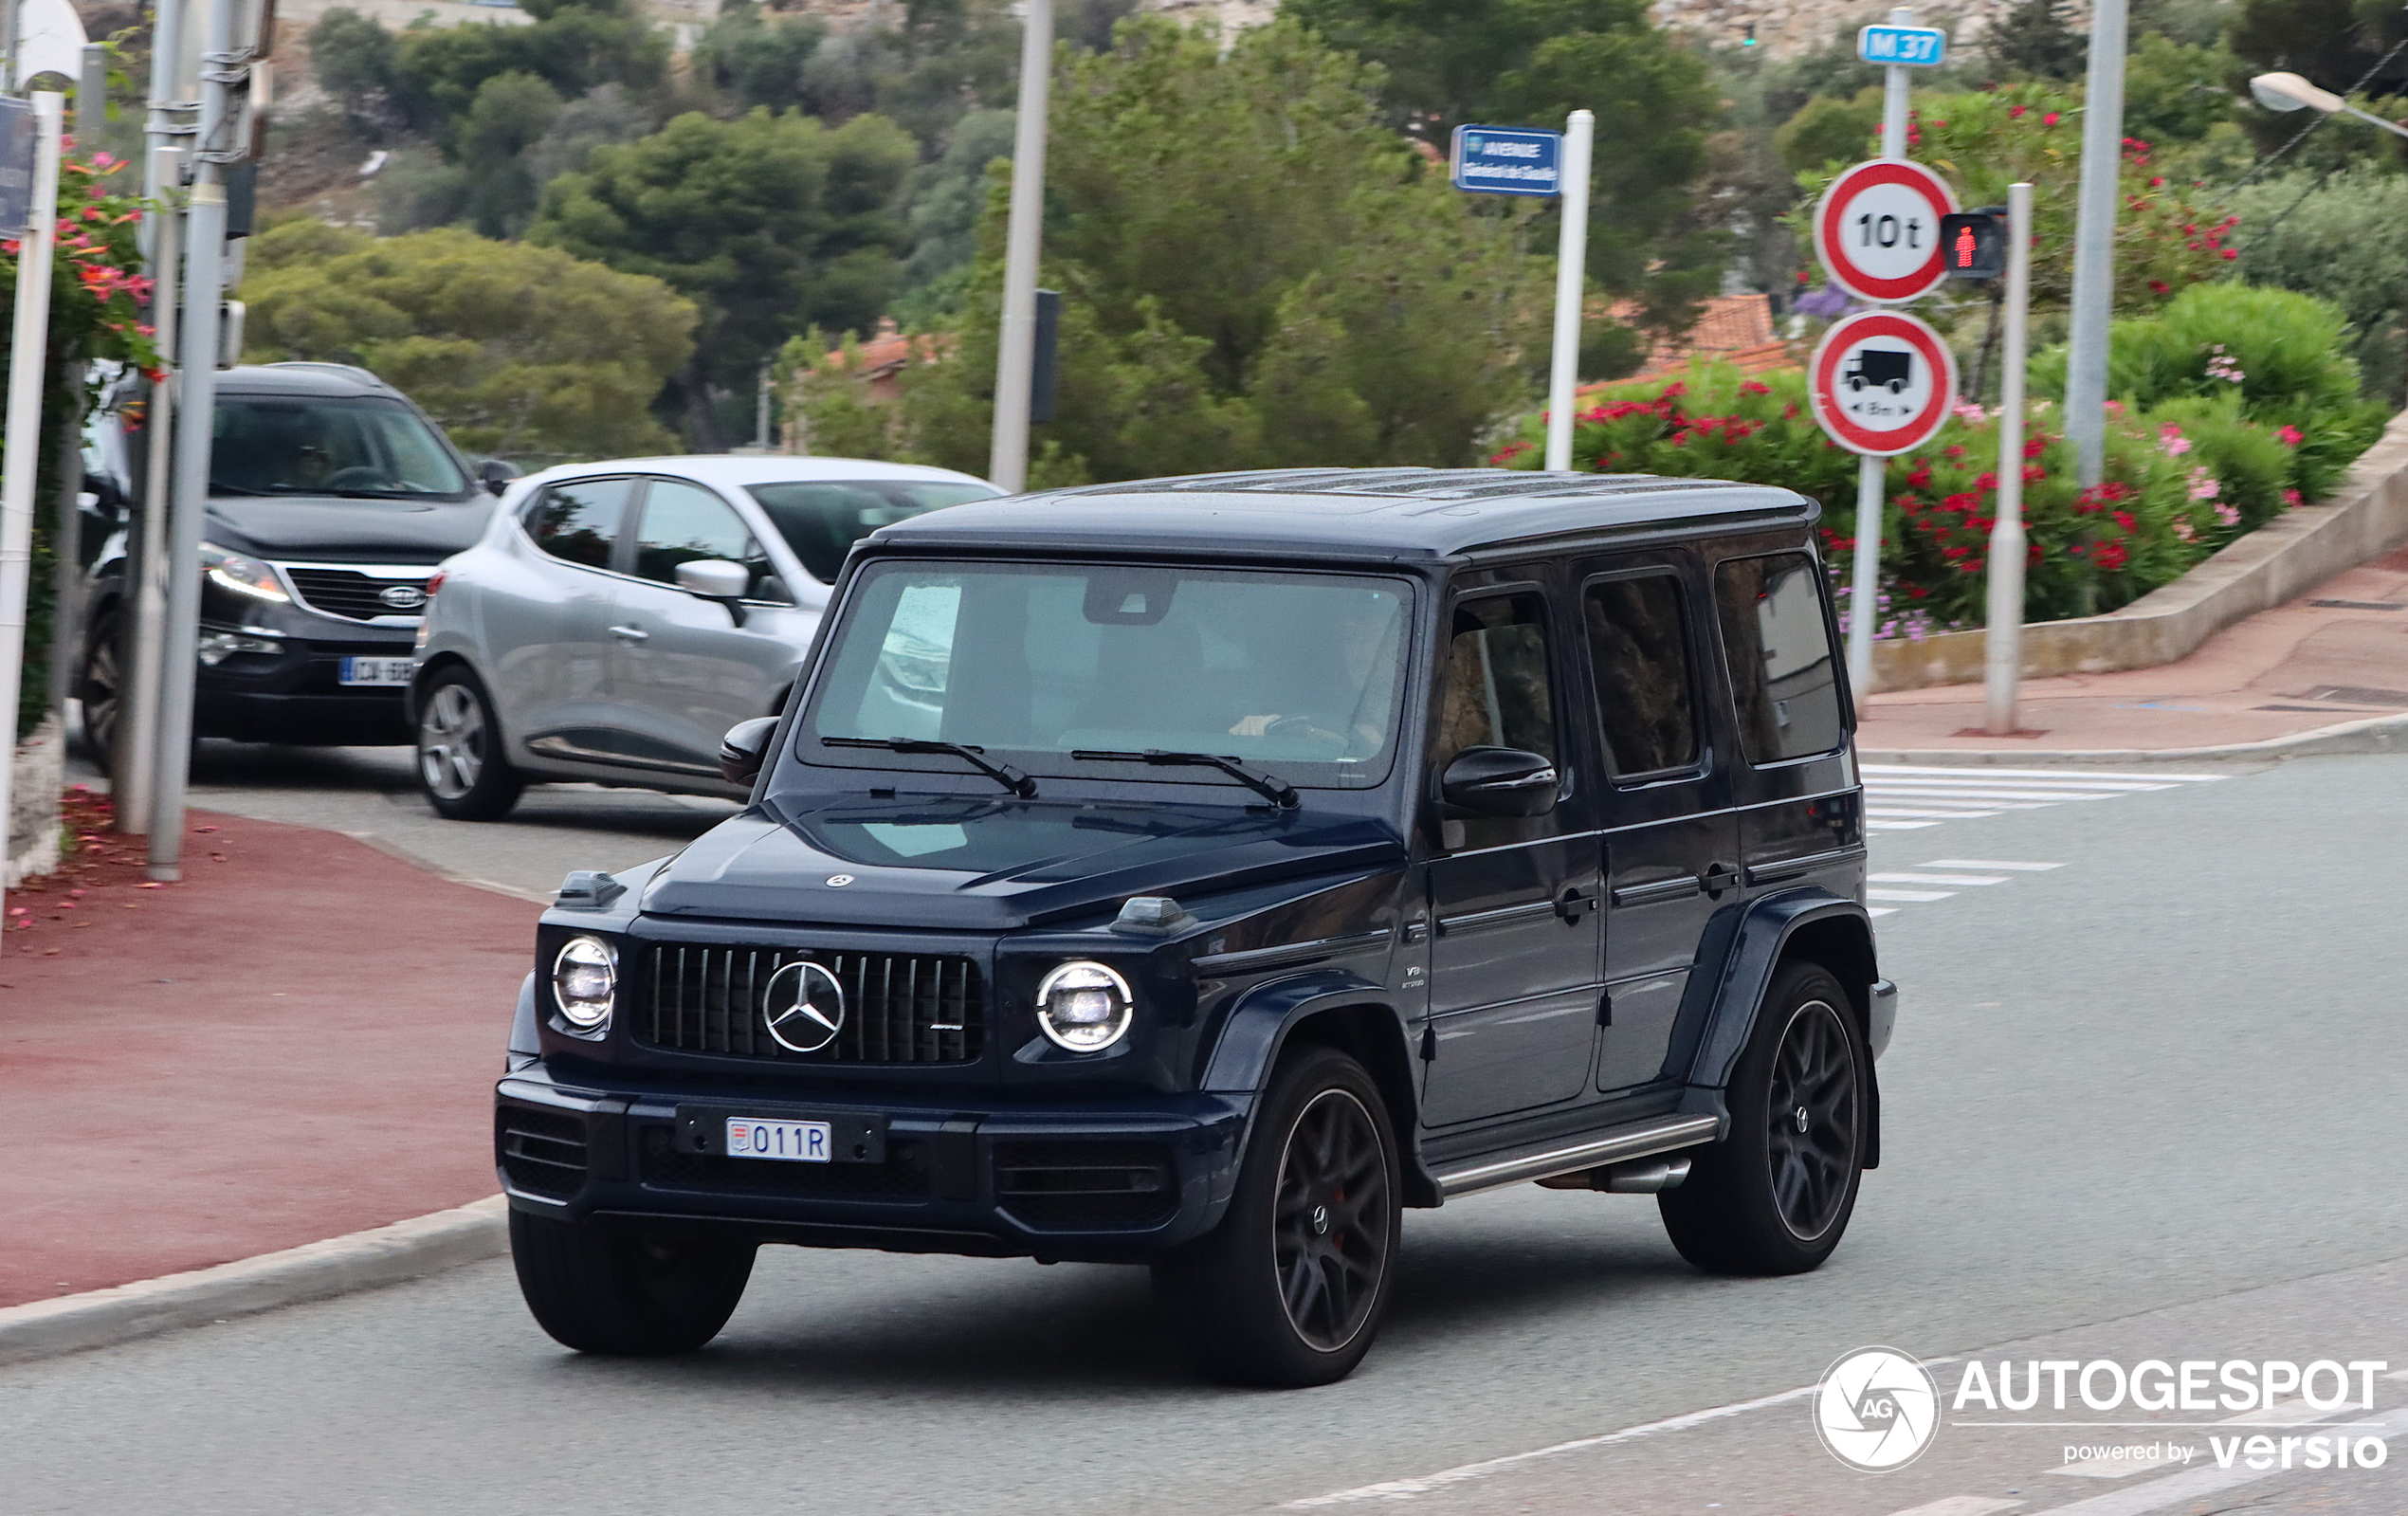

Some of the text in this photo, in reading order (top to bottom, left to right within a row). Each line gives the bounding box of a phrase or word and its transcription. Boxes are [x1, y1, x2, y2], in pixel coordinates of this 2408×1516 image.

[1869, 32, 1936, 60] M 37
[1405, 965, 1421, 977] V8
[754, 1125, 824, 1157] 011R
